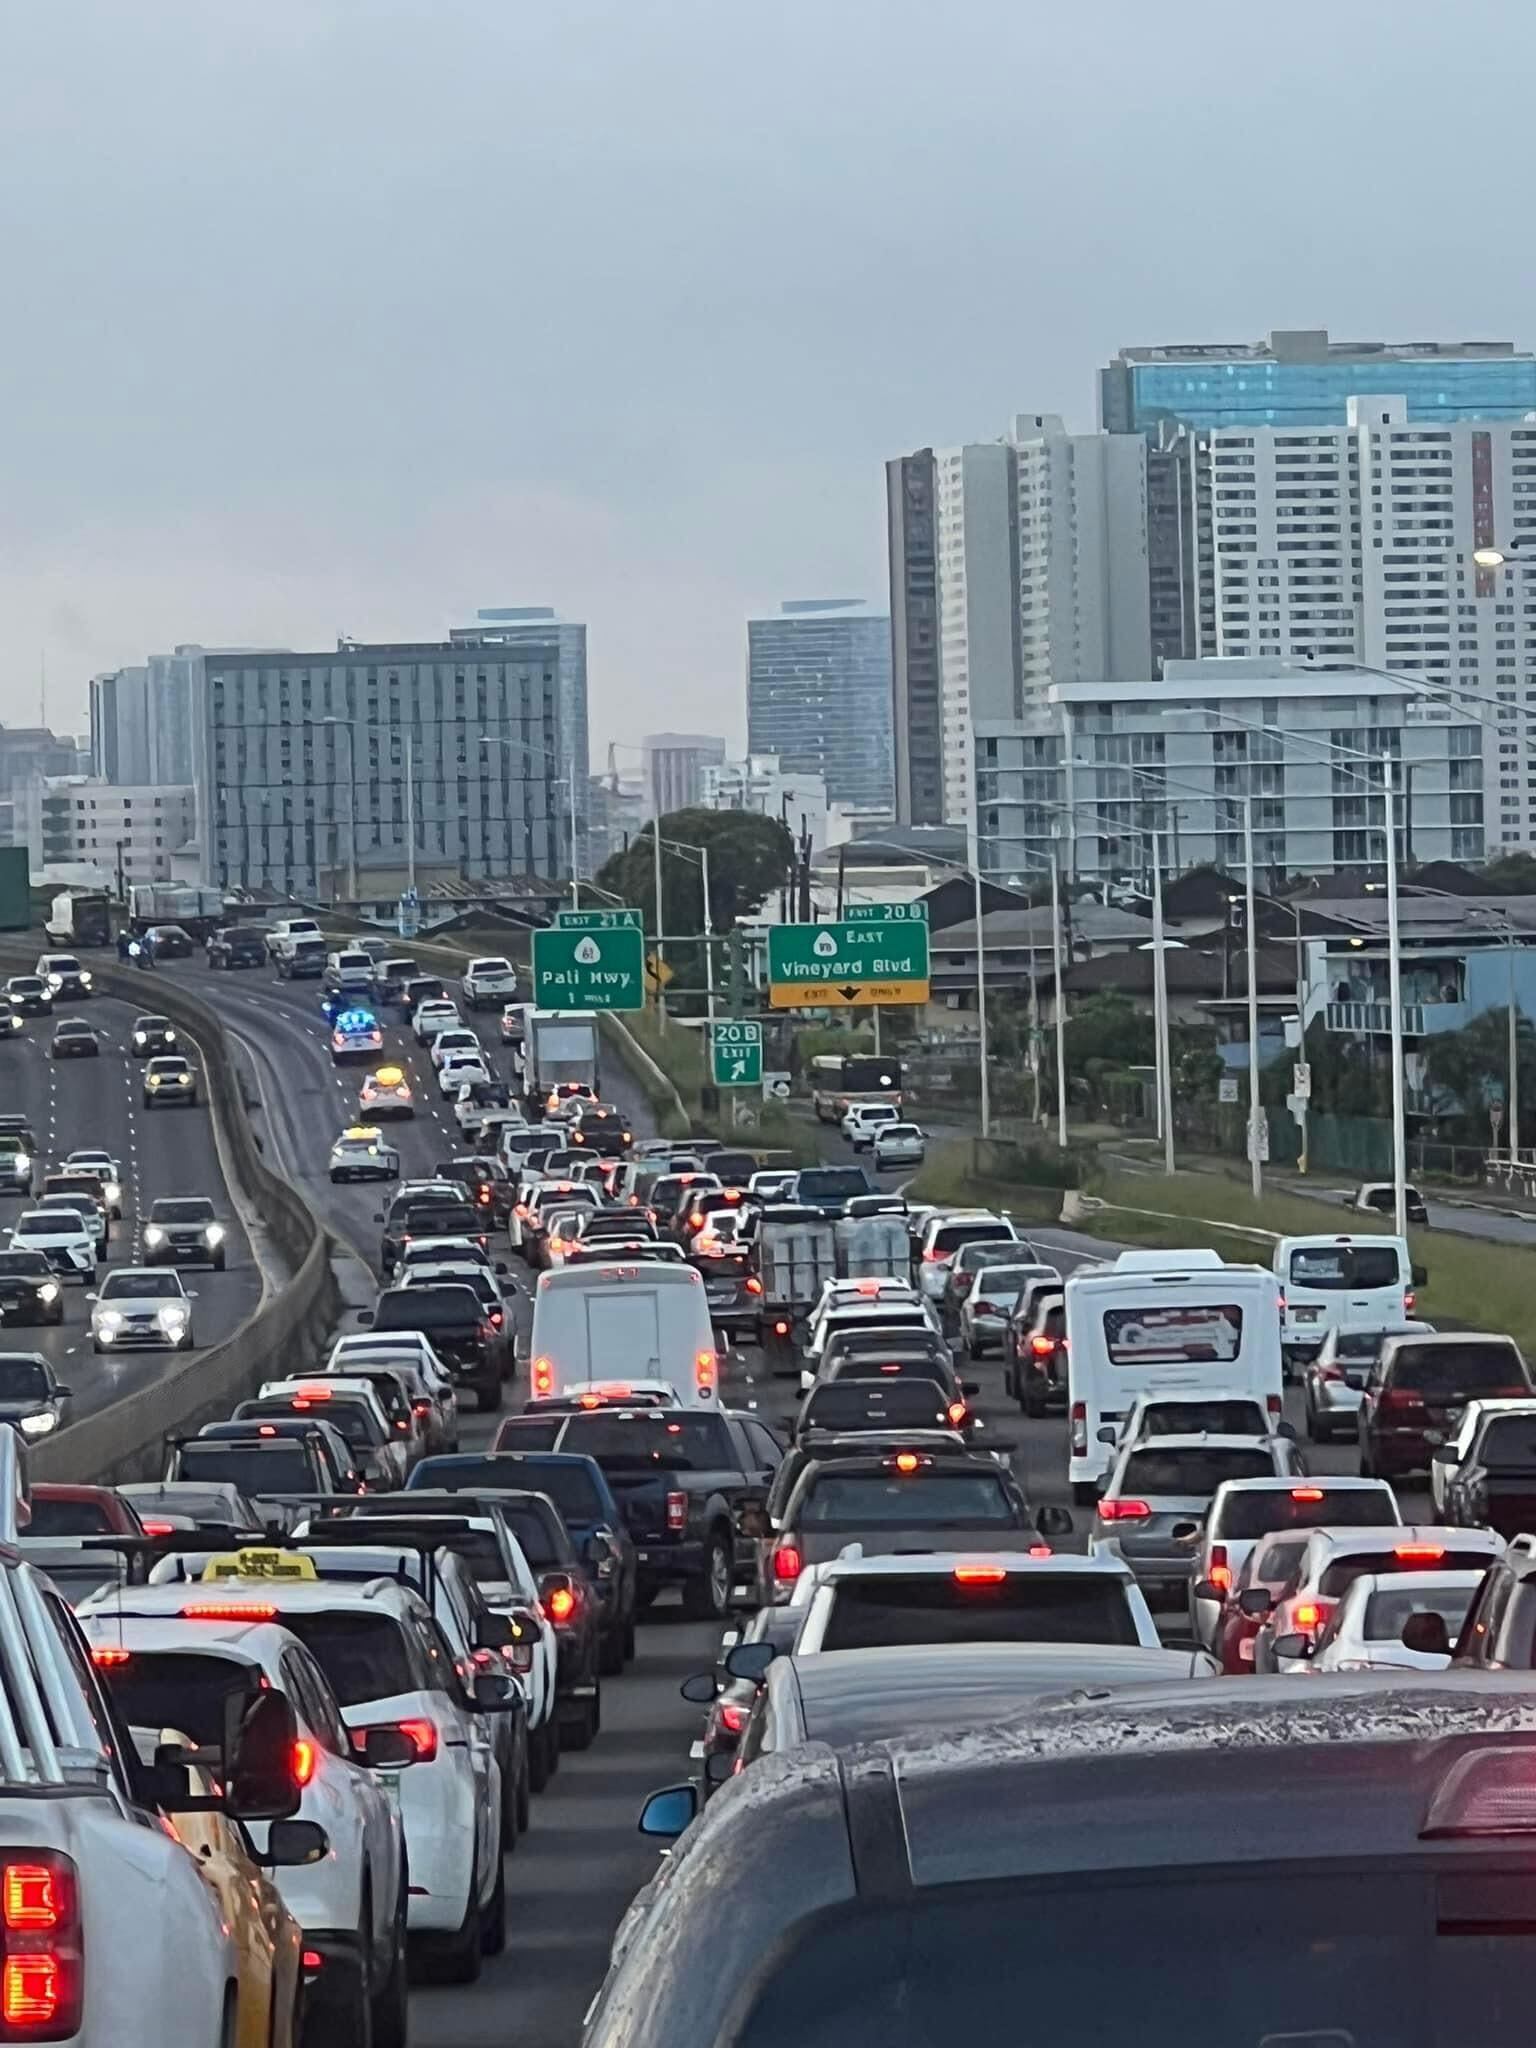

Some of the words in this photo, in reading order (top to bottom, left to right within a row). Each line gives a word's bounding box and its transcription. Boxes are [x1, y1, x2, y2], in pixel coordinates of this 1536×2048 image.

[542, 969, 580, 985] Pali
[781, 960, 863, 979] Vineyard
[722, 1047, 751, 1058] EXIT
